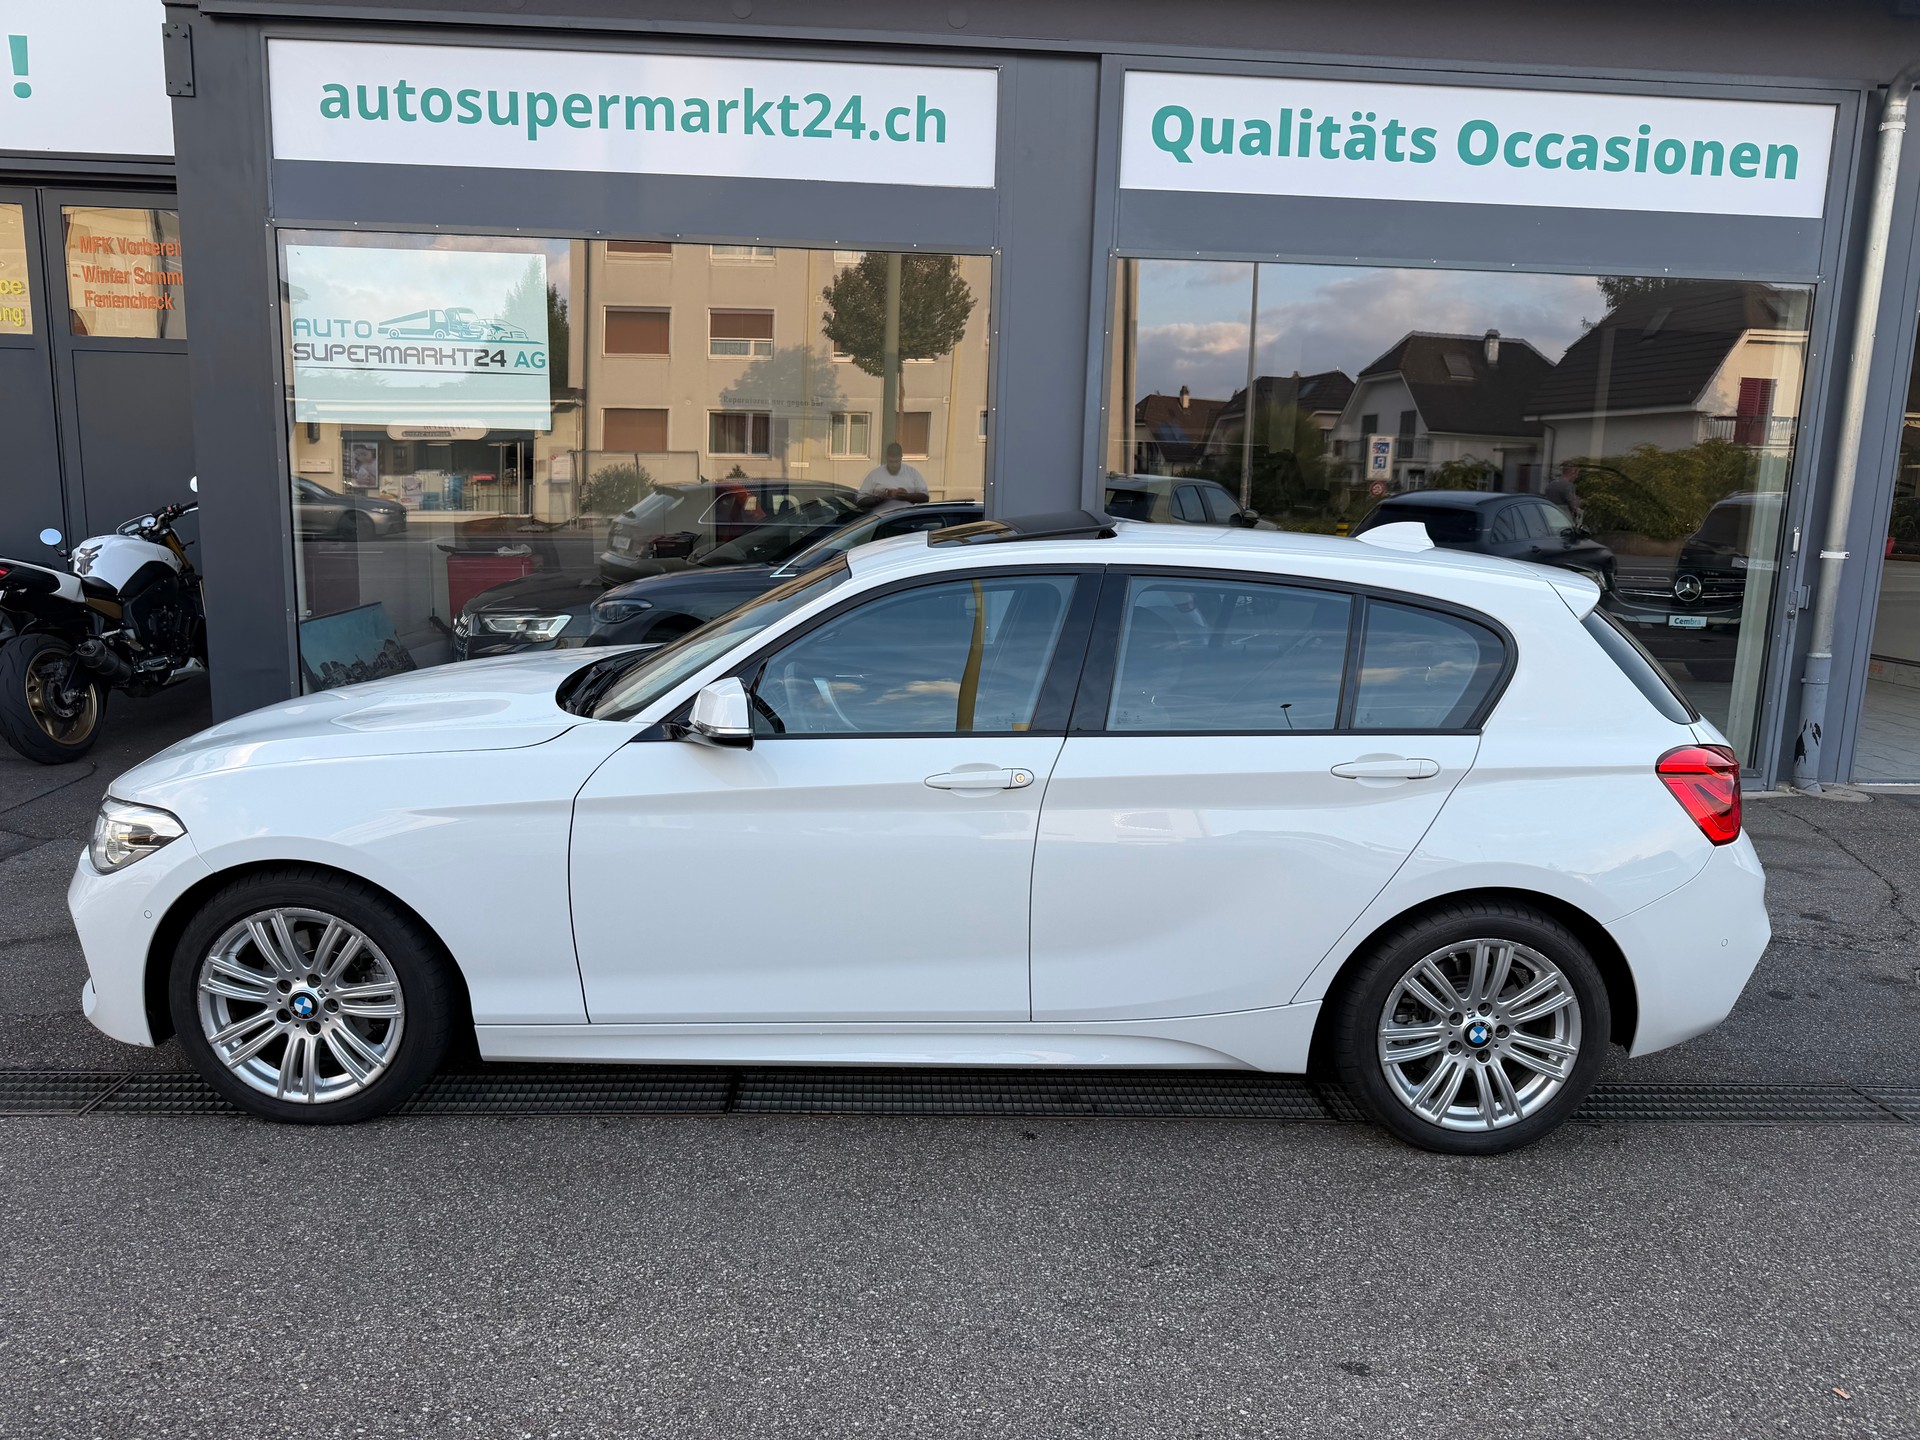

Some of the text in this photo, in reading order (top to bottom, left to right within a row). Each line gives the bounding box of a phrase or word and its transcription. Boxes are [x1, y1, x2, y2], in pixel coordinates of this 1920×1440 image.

[319, 78, 948, 145] autosupermarkt24.ch
[1150, 104, 1799, 181] Qualitäts Occasionen
[79, 235, 114, 255] MFK
[81, 265, 130, 284] Winter
[83, 289, 176, 310] Feriencheck
[292, 317, 372, 340] AUTO
[293, 342, 546, 369] SUPERMARKT24 AG
